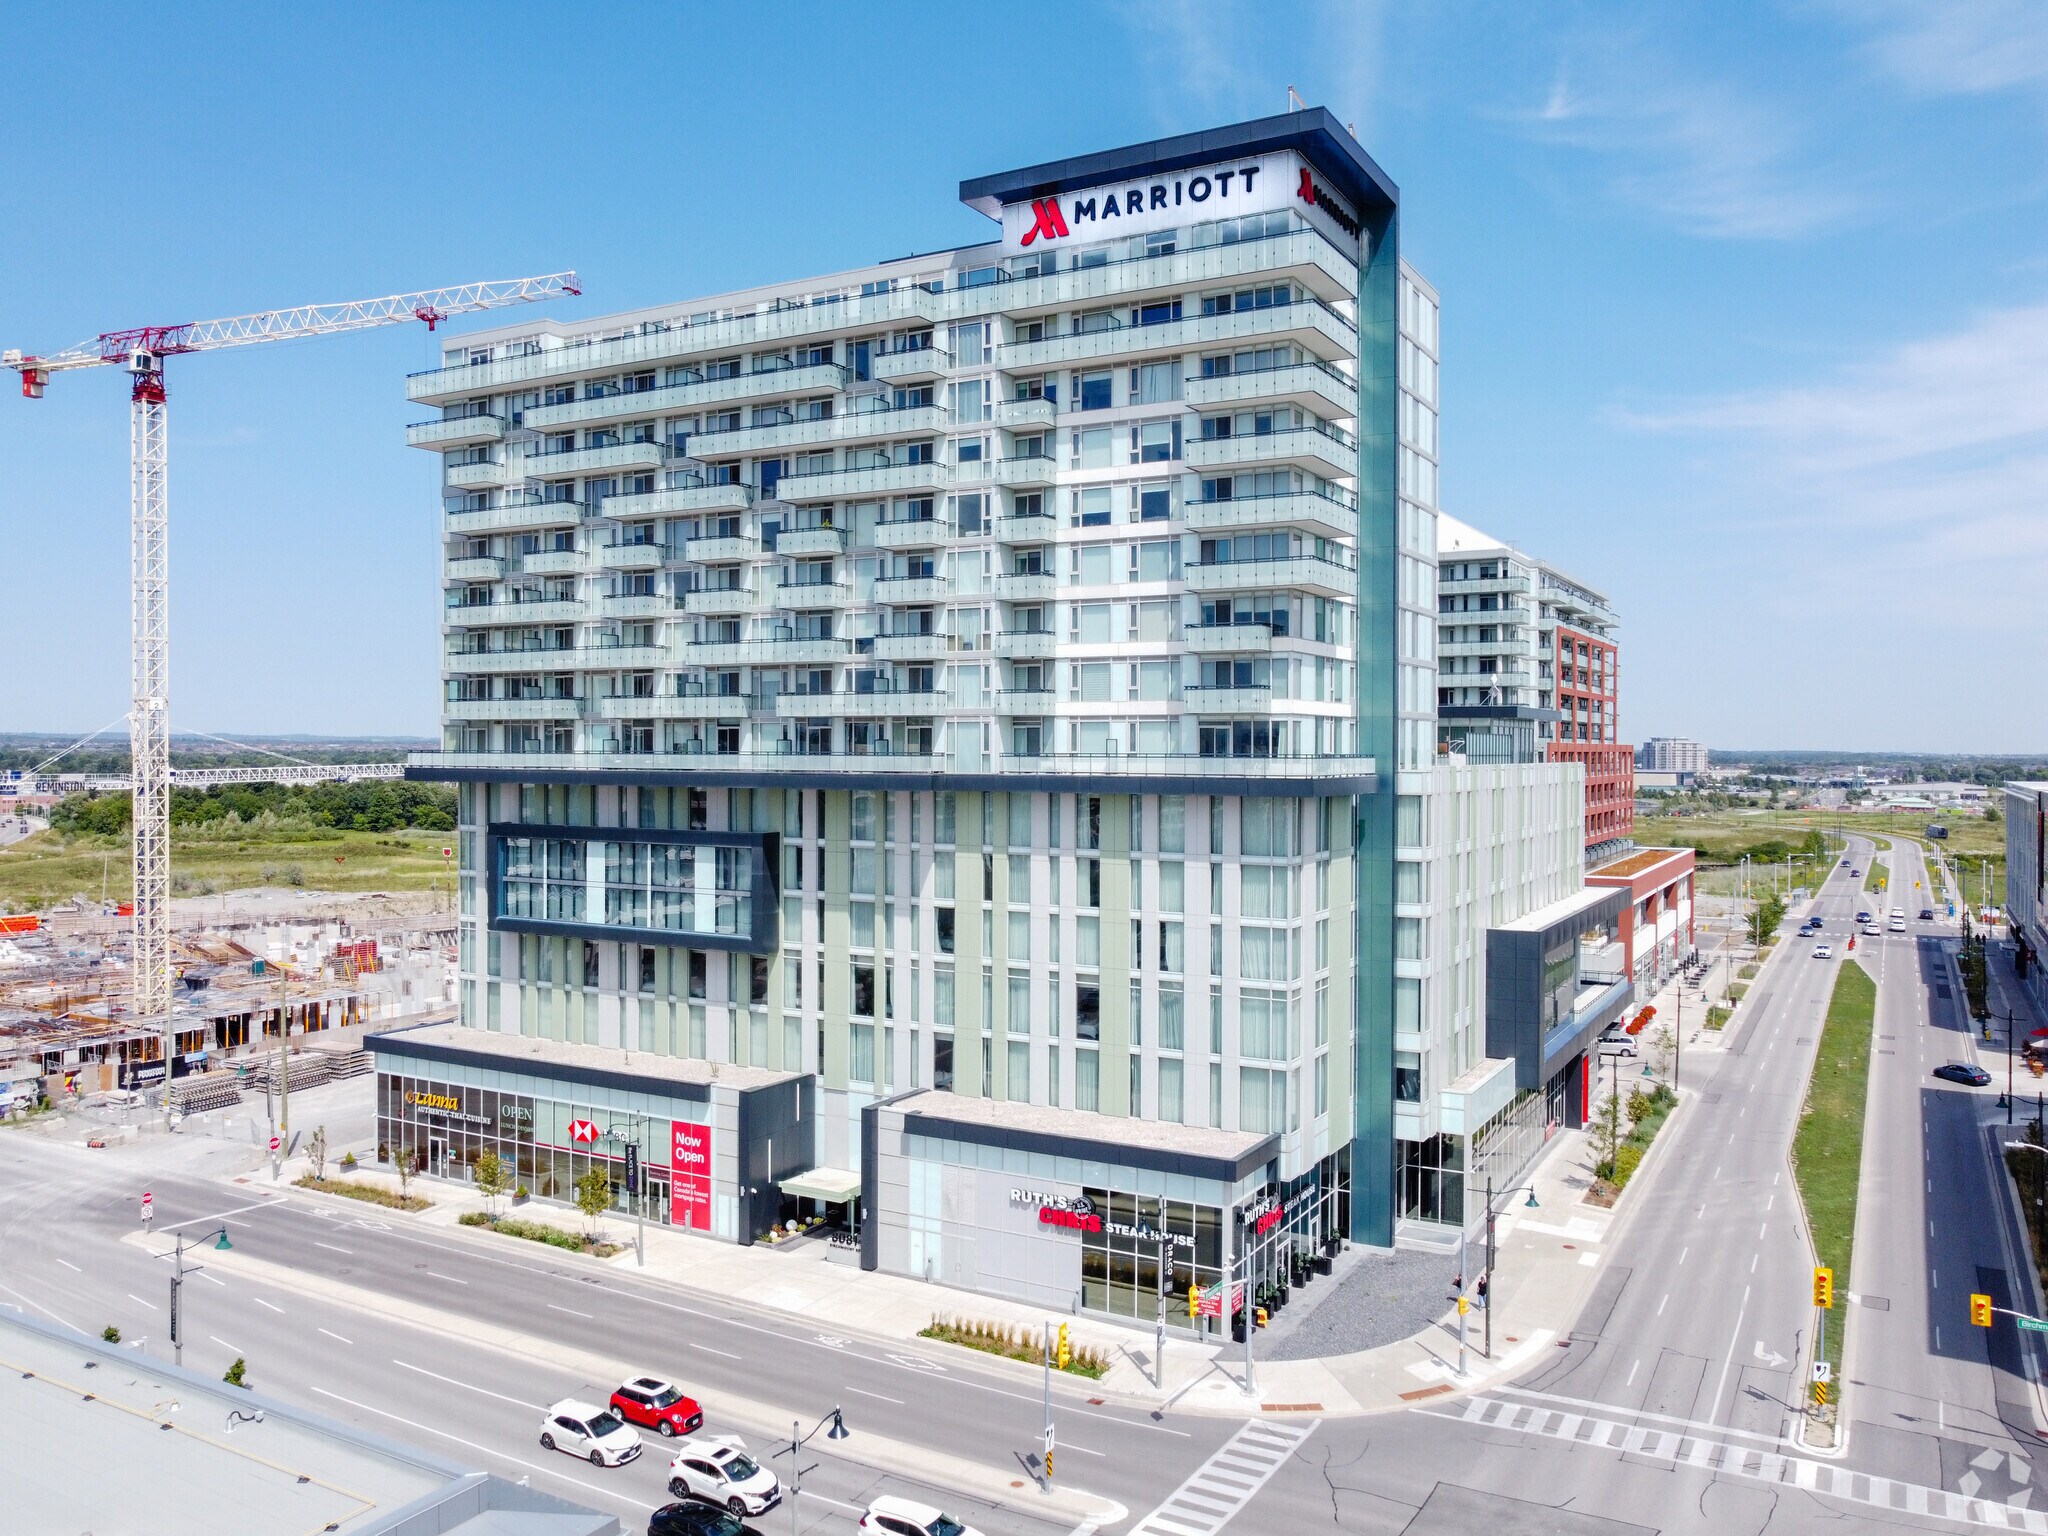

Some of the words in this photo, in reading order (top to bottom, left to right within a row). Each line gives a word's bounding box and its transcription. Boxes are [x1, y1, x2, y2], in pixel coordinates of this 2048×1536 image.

[1075, 166, 1259, 224] MARRIOTT
[36, 781, 86, 792] REMINGTON
[416, 1091, 459, 1111] Lanna
[417, 1106, 449, 1117] AUTHENTIC
[467, 1115, 492, 1125] CUISINE
[502, 1104, 533, 1121] OPEN
[602, 1129, 628, 1142] HBC
[676, 1132, 702, 1148] Now
[675, 1148, 705, 1163] Open
[1010, 1188, 1068, 1209] RUTH'S
[1039, 1207, 1102, 1234] CHRIS
[1257, 1204, 1284, 1236] CHRIS
[1106, 1223, 1148, 1240] STEAK
